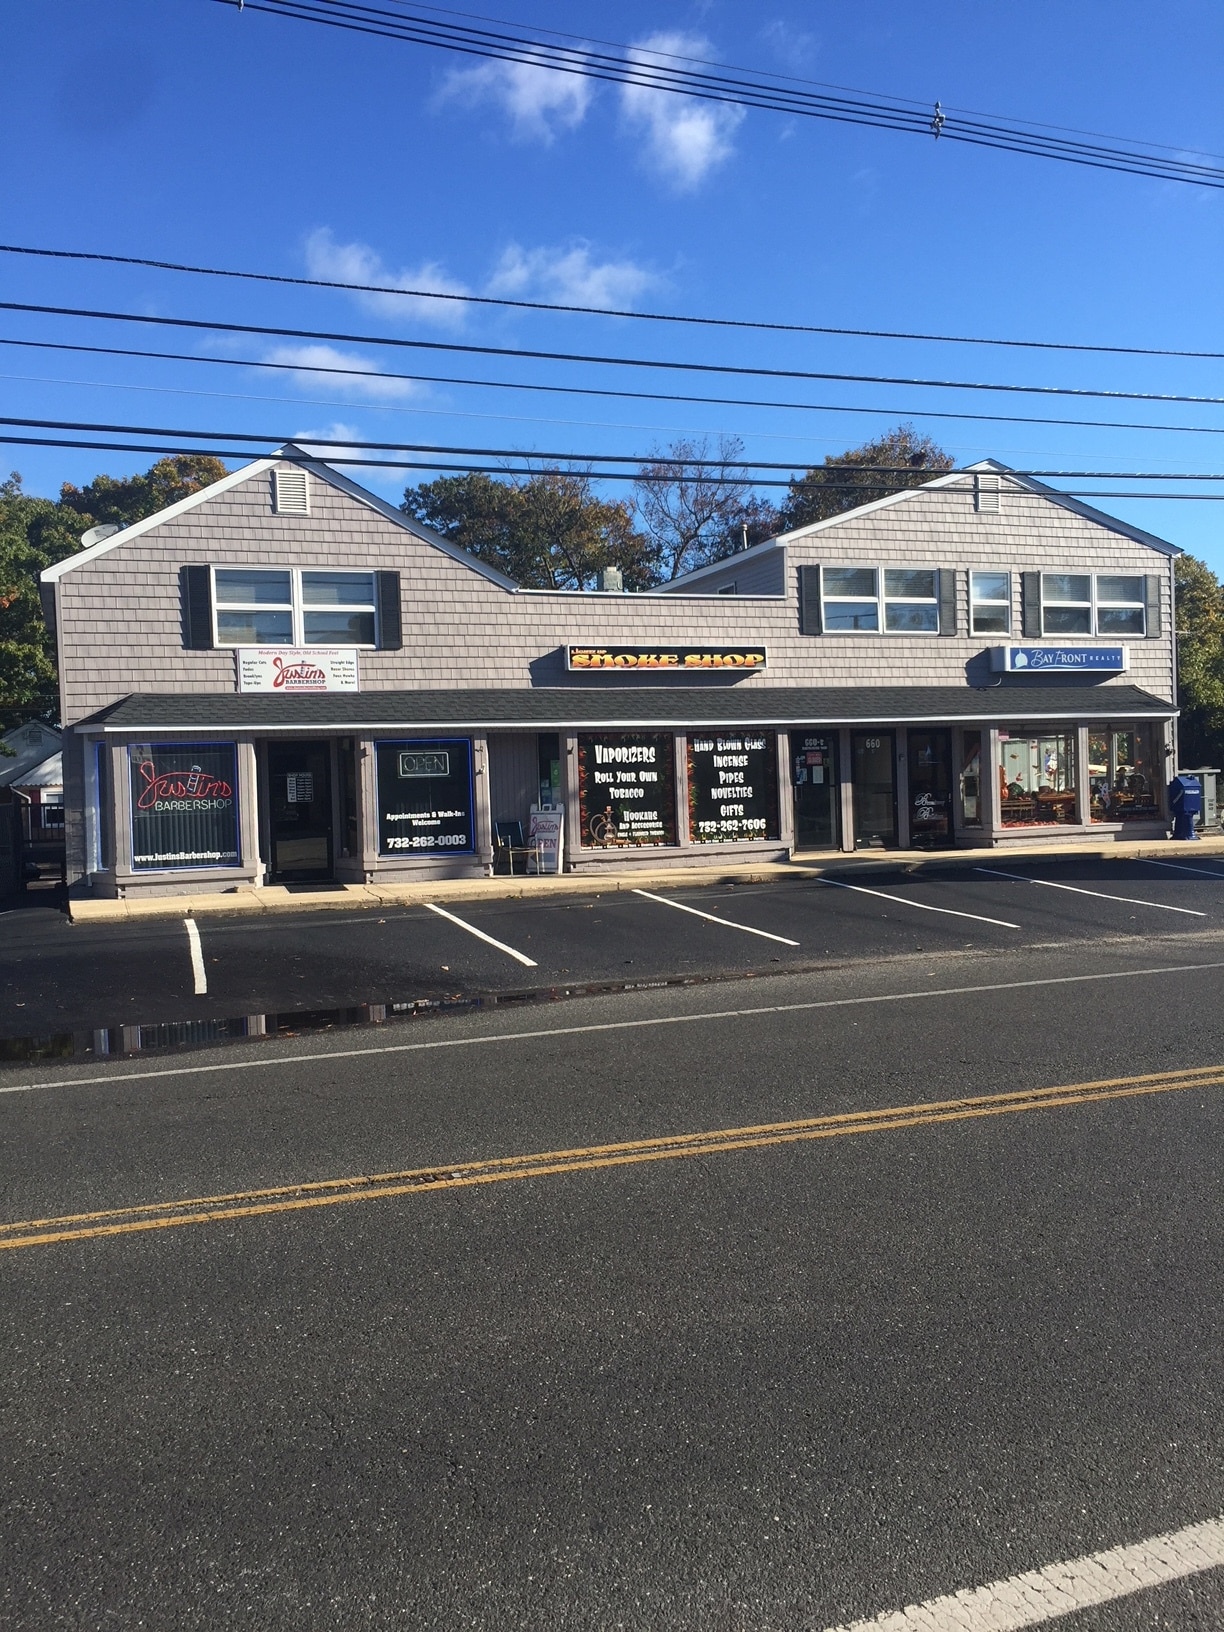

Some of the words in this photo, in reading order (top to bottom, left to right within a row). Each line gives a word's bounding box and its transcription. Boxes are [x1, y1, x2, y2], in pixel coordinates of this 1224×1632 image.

[572, 654, 679, 667] SMOKE
[685, 654, 765, 667] SHOP
[693, 738, 714, 752] HAND
[717, 737, 742, 751] BLOWN
[744, 736, 766, 751] GLASS
[865, 738, 881, 749] 660
[594, 745, 656, 764] VAPORIZERS
[713, 754, 749, 768] INCENSE
[403, 754, 445, 772] OPEN
[594, 771, 614, 784] ROLL
[616, 770, 637, 783] YOUR
[639, 770, 658, 782] OWN
[718, 771, 745, 785] PIPES
[609, 787, 645, 799] TOBACCO
[711, 786, 753, 800] NOVELTIES
[155, 798, 233, 811] BARBERSHOP
[720, 804, 745, 817] GIFTS
[386, 812, 430, 821] Appointments
[623, 811, 658, 821] HOOKAHS
[698, 818, 767, 832] 732-262-7606
[386, 834, 467, 849] 732-262-0003
